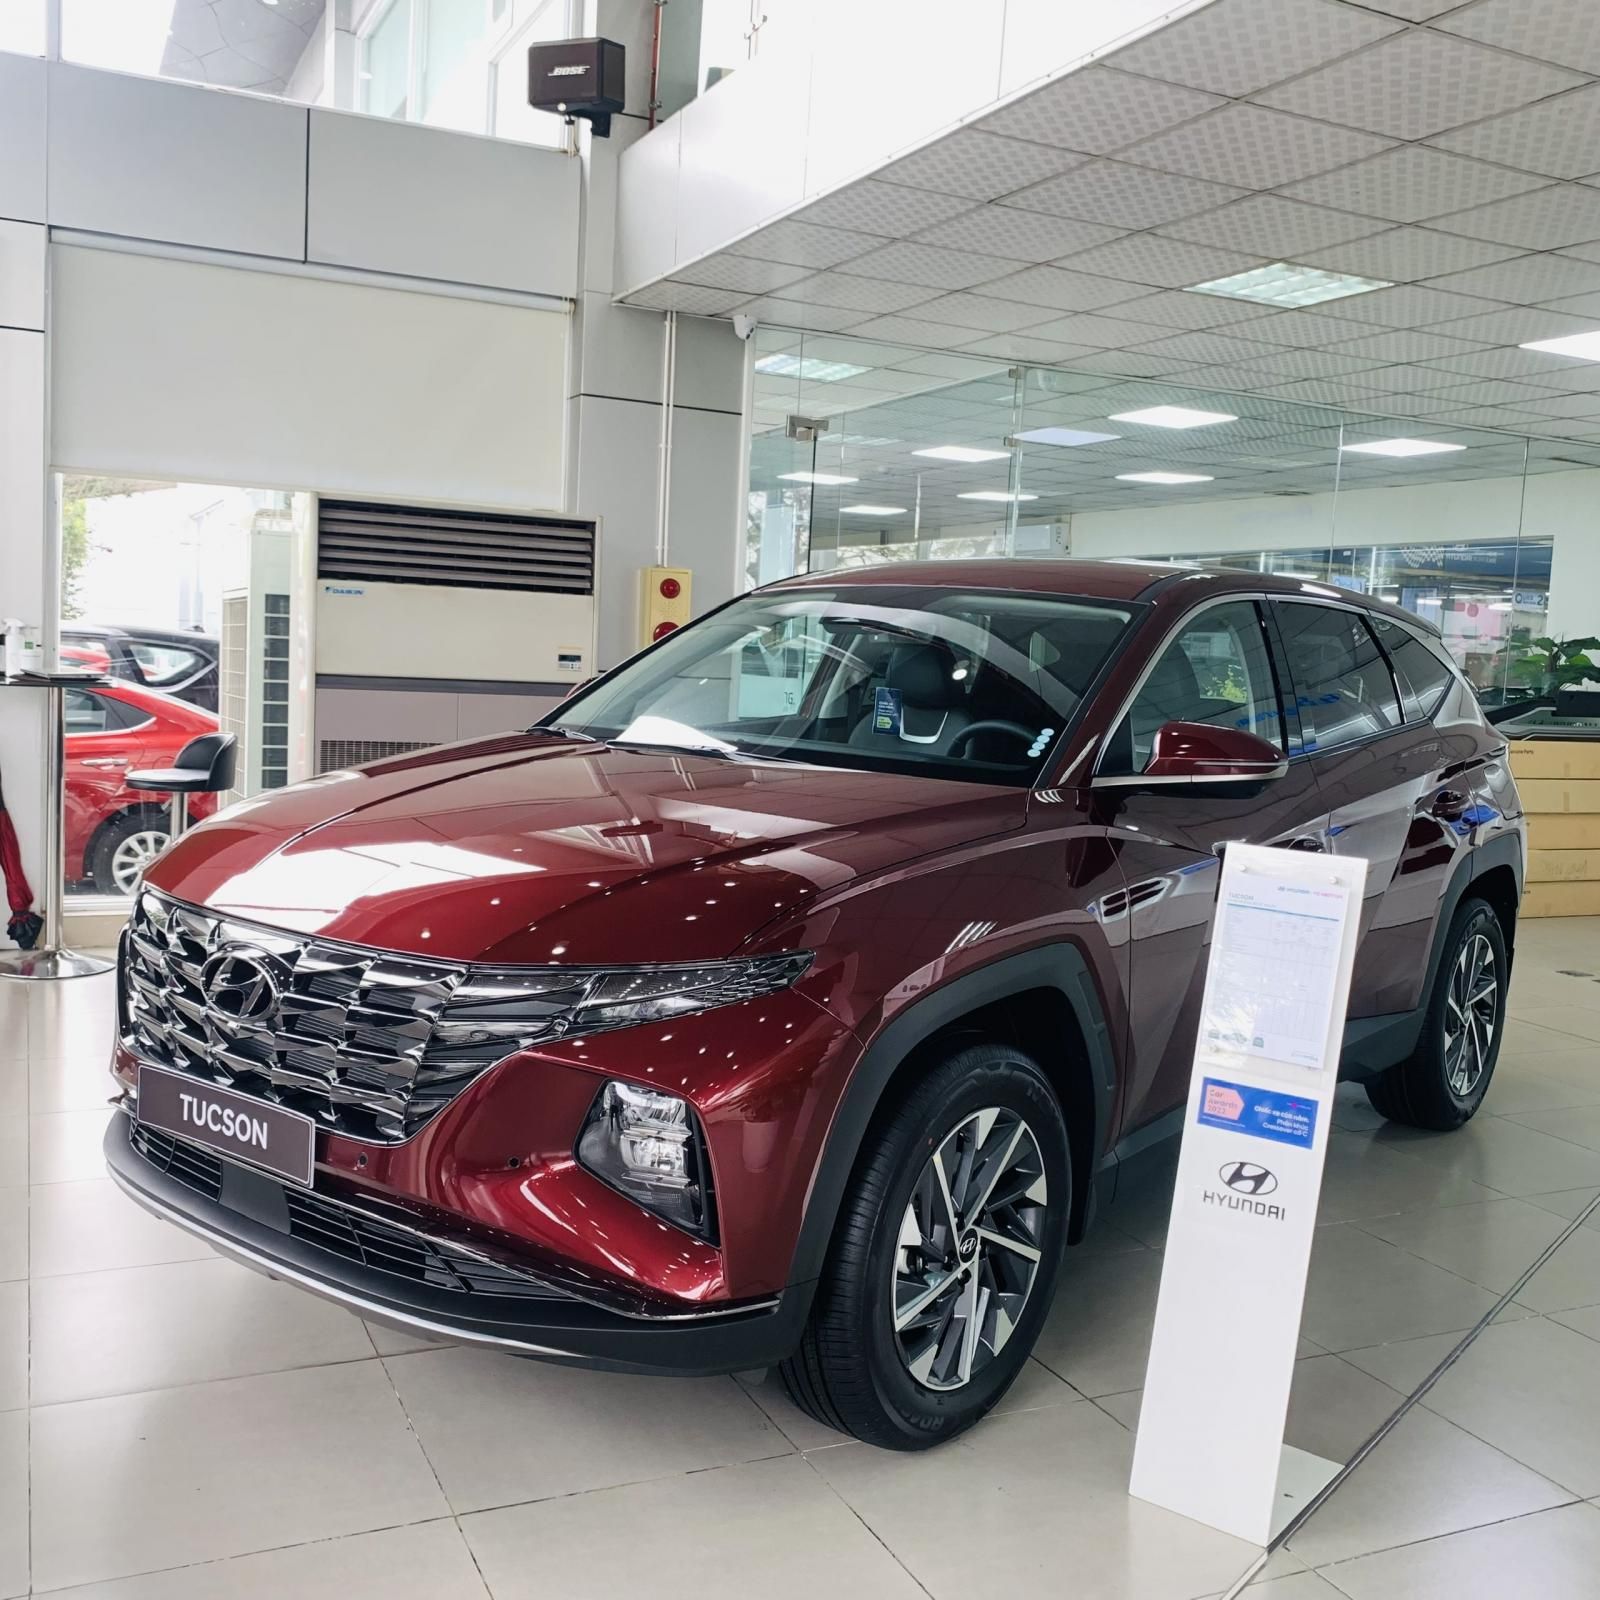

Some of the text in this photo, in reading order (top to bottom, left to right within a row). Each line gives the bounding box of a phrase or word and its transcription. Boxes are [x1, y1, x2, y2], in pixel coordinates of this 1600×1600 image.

[548, 66, 590, 76] BOSE
[1209, 1089, 1224, 1098] Car
[179, 1093, 268, 1150] TUCSON
[1203, 1190, 1285, 1221] HYUNDAI
